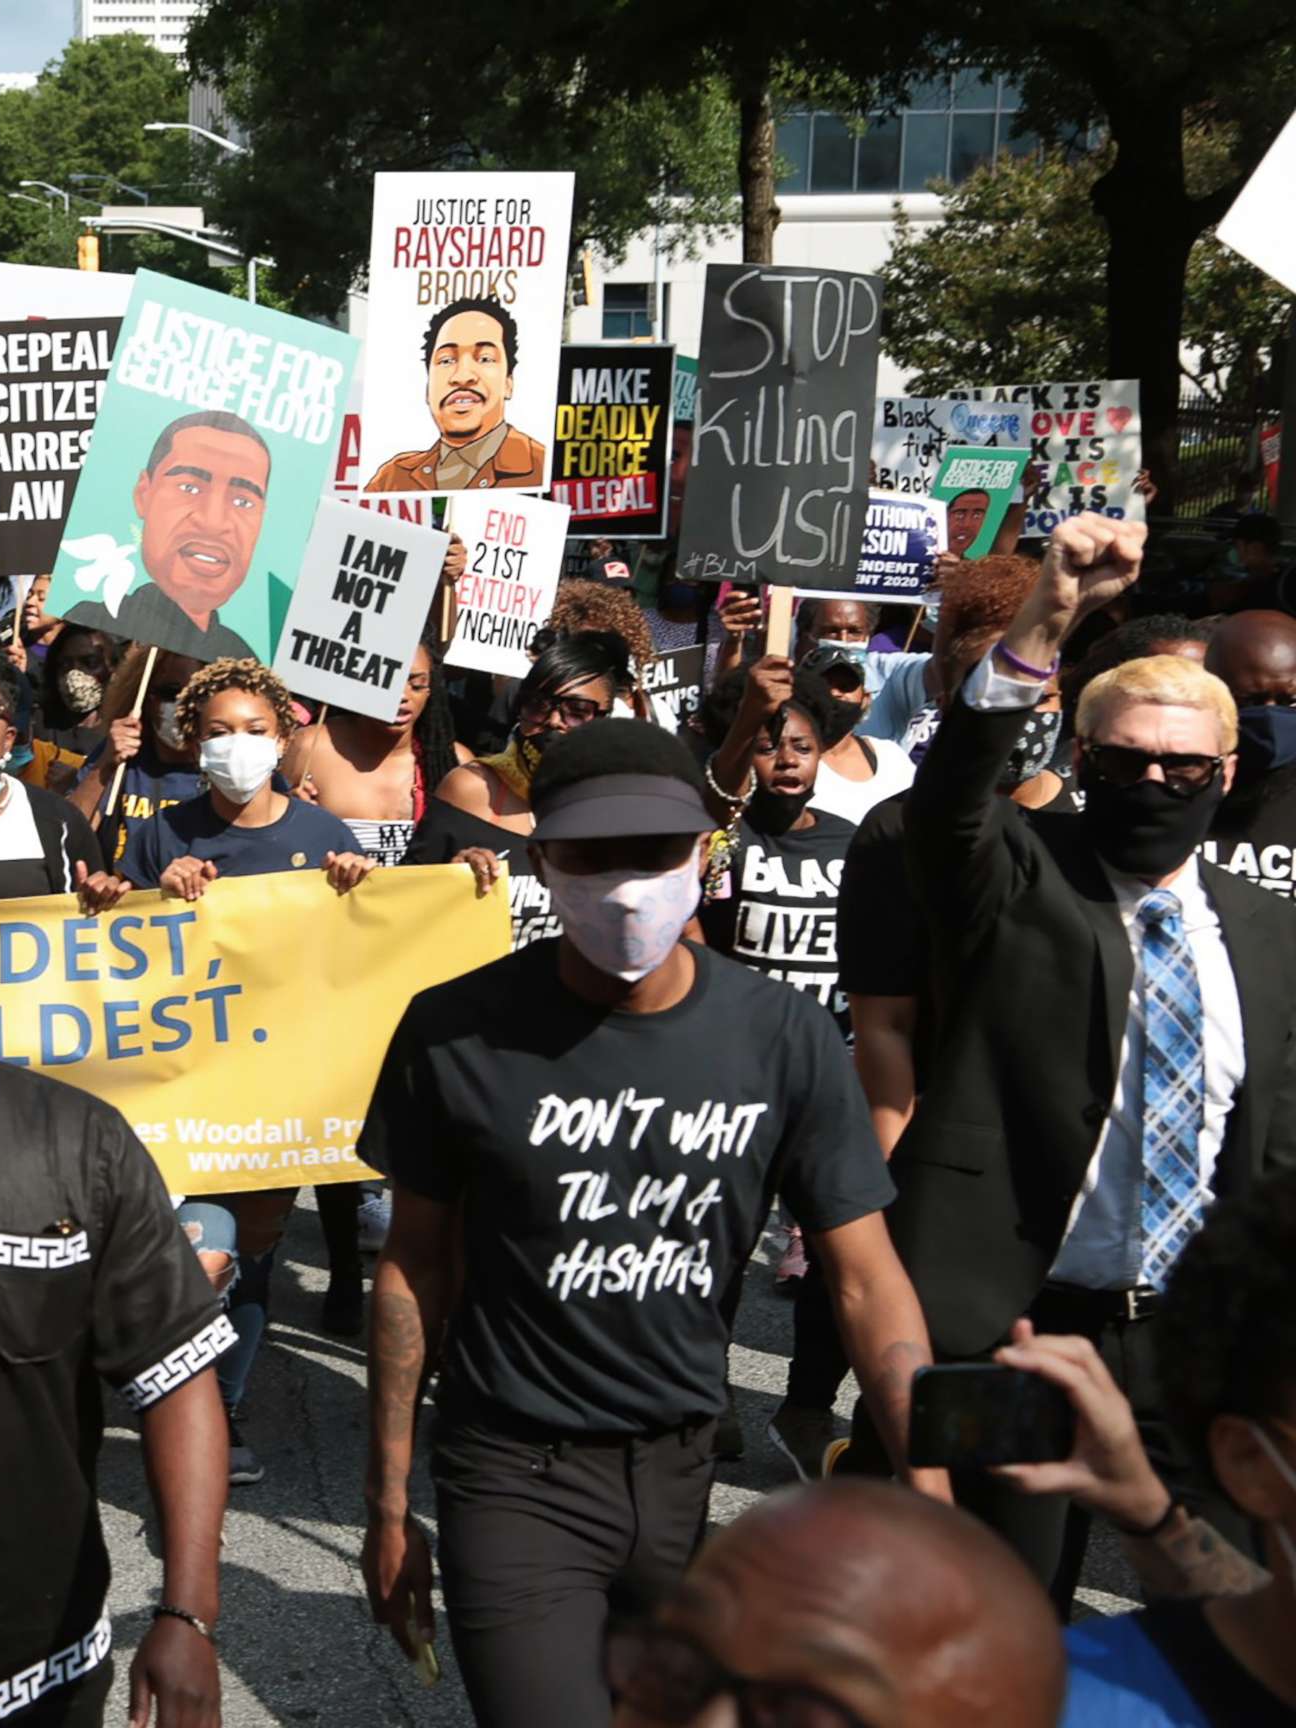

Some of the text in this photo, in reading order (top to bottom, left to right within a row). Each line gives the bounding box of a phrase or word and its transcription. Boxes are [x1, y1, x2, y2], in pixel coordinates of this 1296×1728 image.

[413, 198, 532, 226] JUSTICE FOR
[393, 226, 546, 268] RAYSHARD
[417, 269, 518, 306] BROOKS
[709, 270, 878, 379] STOP
[131, 300, 344, 407] JUSTICE FOR
[570, 368, 652, 405] MAKE
[1064, 384, 1102, 409] IS
[237, 376, 336, 445] FLOYD
[555, 404, 661, 442] DEADLY
[883, 400, 944, 433] Black
[562, 439, 650, 478] FORCE
[553, 476, 654, 516] ILLEGAL
[879, 468, 932, 494] Black
[484, 509, 526, 547] END
[340, 534, 408, 583] I AM
[472, 541, 528, 581] 21ST
[682, 552, 758, 580] #BLM
[332, 570, 395, 614] NOT
[455, 574, 542, 619] ENTURY
[339, 611, 362, 644] A
[289, 628, 403, 691] THREAT
[175, 1116, 312, 1146] Woodall,
[323, 1116, 365, 1140] Pr
[528, 1086, 769, 1163] DON'T WAIT
[188, 1143, 364, 1173] www.naac
[546, 1234, 714, 1303] HASHTAG
